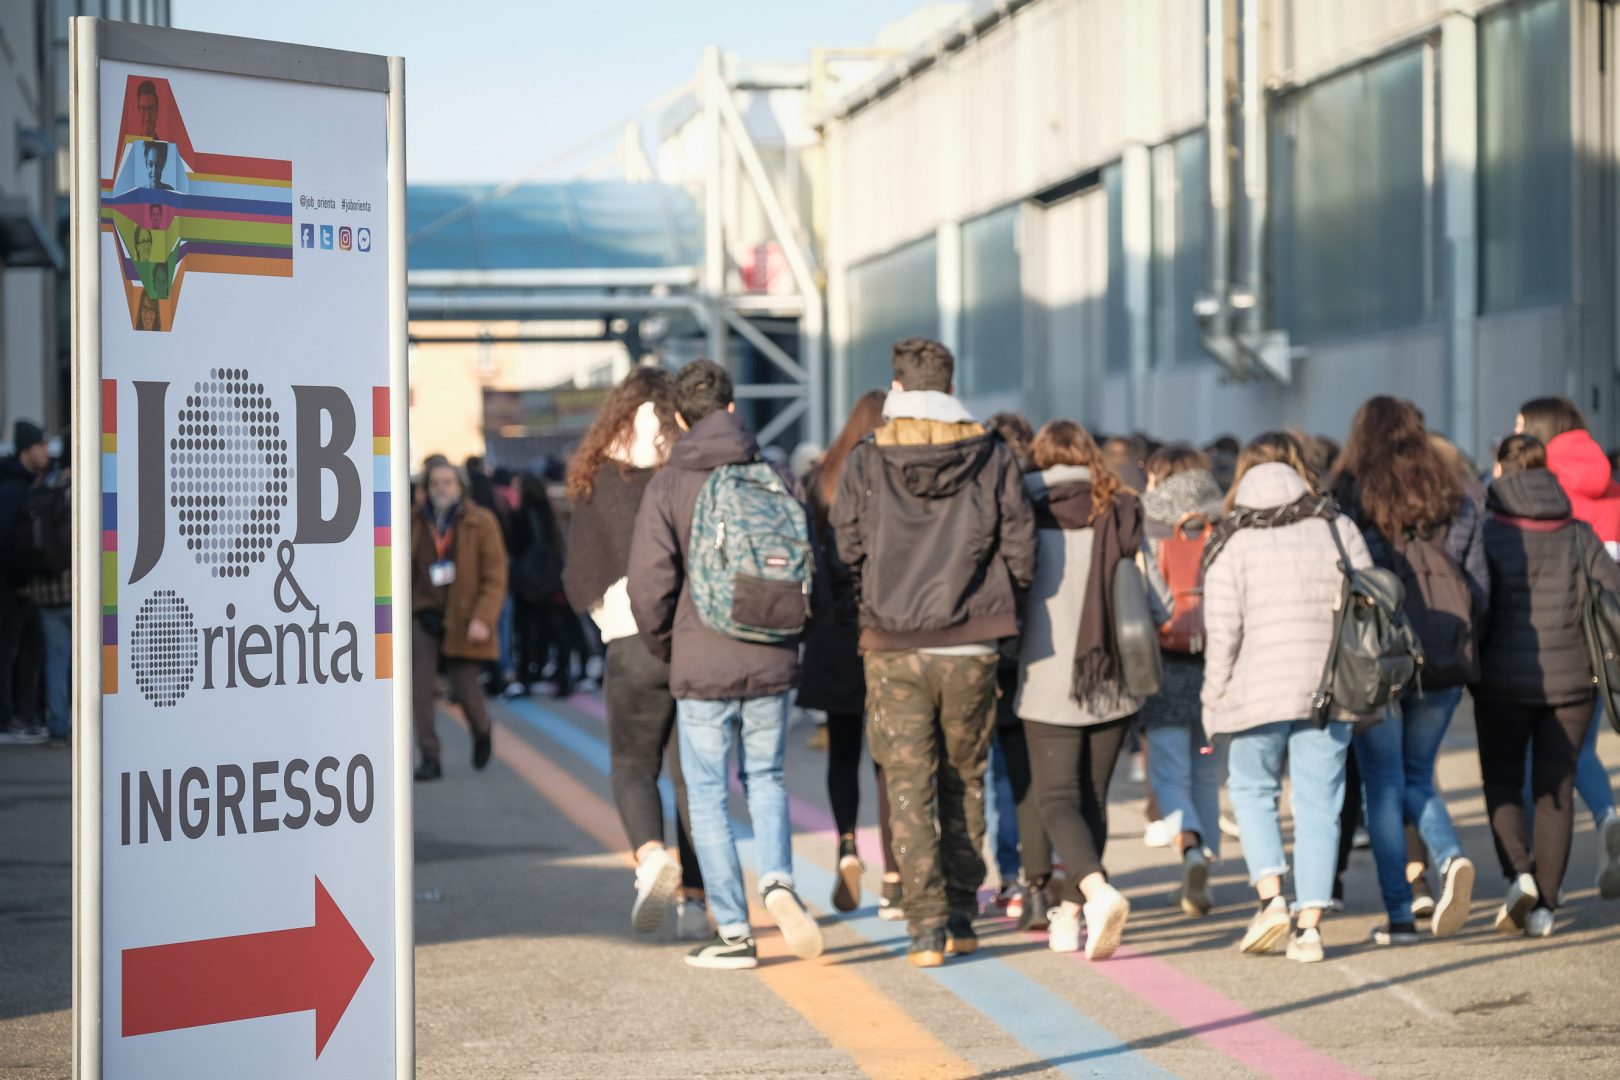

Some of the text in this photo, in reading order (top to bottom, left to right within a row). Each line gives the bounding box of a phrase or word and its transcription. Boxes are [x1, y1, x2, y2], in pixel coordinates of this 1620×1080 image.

[128, 368, 362, 586] JOB
[131, 589, 363, 708] Orienta
[121, 753, 375, 846] INGRESSO
